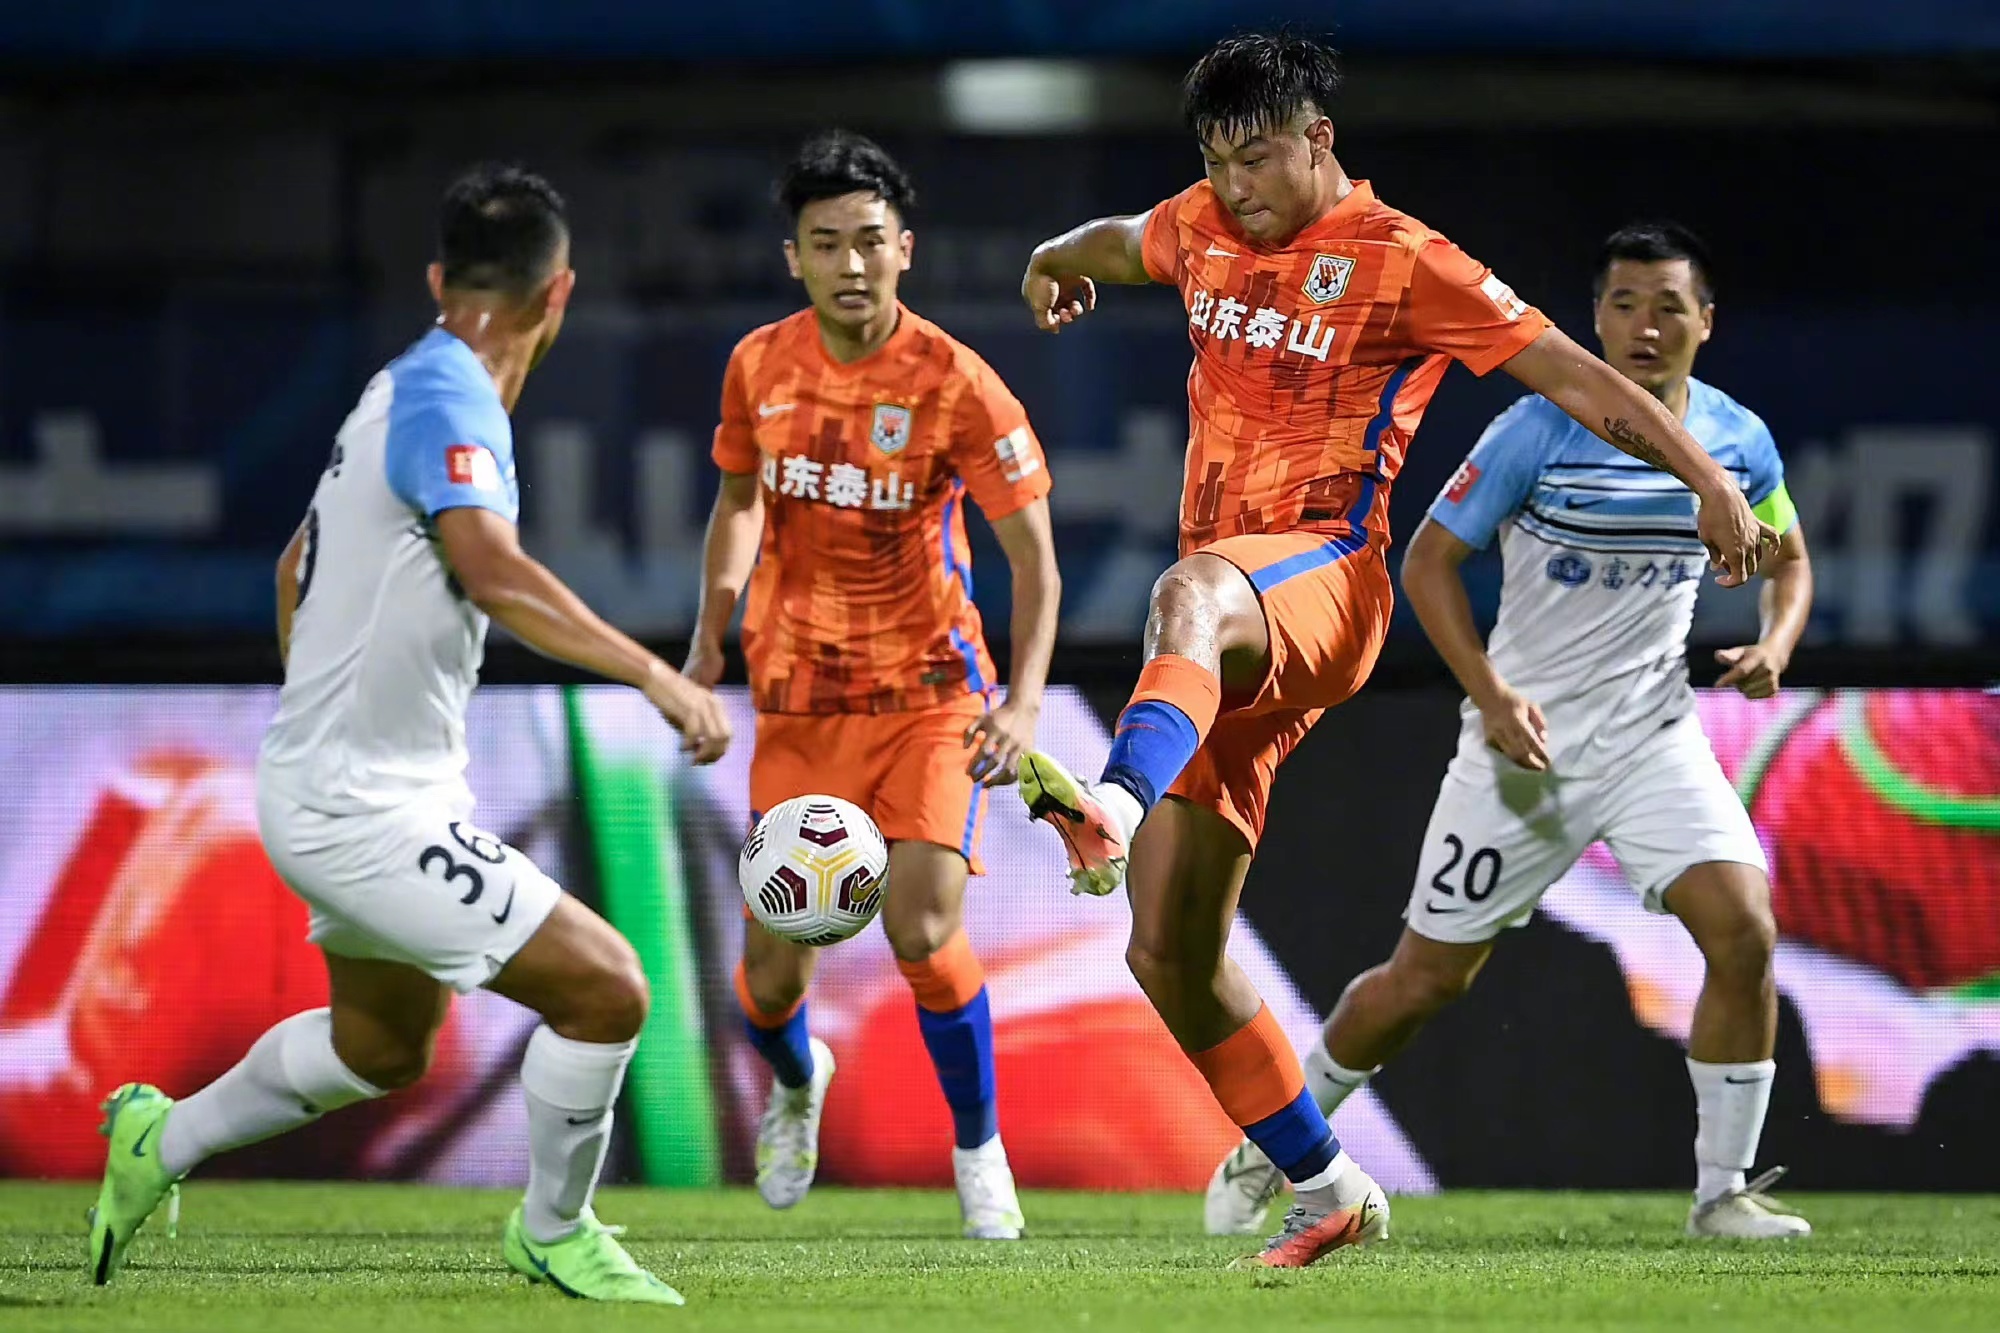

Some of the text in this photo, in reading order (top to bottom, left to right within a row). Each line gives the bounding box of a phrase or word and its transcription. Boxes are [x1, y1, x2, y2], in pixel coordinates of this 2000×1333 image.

[1190, 288, 1336, 362] 山东泰山
[419, 822, 506, 905] 36
[1431, 833, 1502, 902] 20
